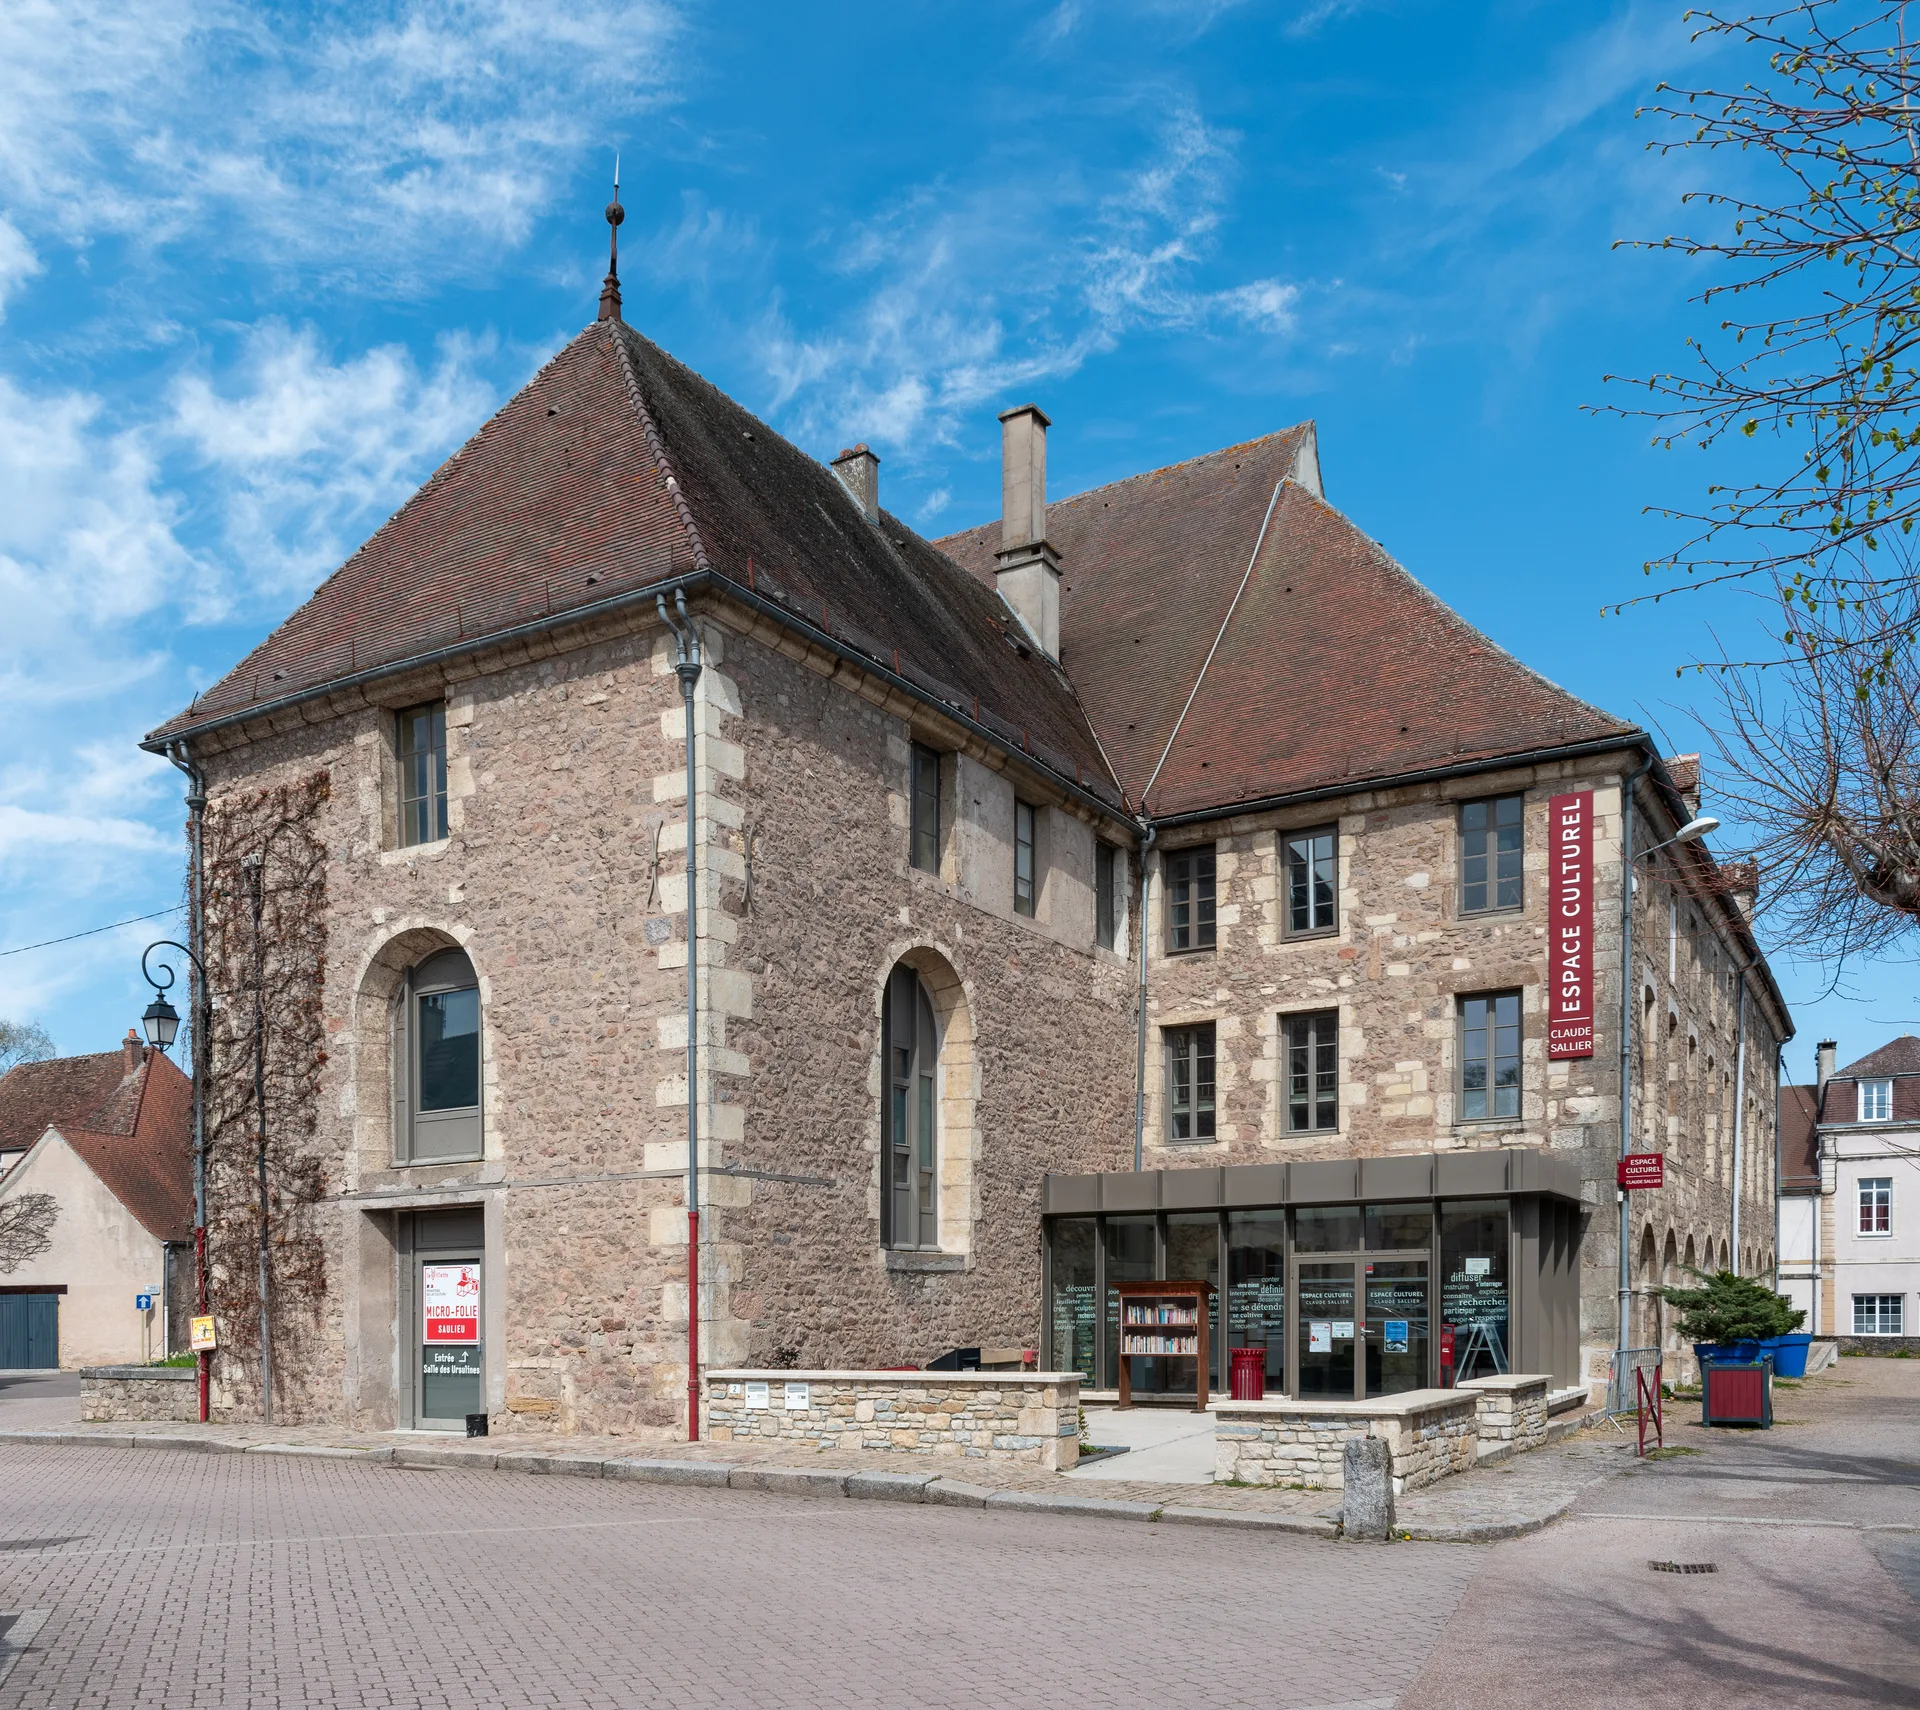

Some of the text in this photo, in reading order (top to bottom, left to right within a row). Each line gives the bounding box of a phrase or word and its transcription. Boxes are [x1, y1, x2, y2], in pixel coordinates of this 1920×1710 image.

[1562, 798, 1581, 1012] ESPACE CULTUREL
[1551, 1026, 1592, 1039] CLAUDE
[1550, 1040, 1592, 1053] SALLIER
[1626, 1166, 1661, 1174] CULTUREL
[1451, 1272, 1483, 1282] diffuser
[1261, 1284, 1283, 1294] définir
[1459, 1298, 1507, 1306] rechercher
[426, 1305, 477, 1317] MICRO-FOLIE
[1444, 1307, 1476, 1316] participer
[438, 1324, 465, 1334] SAULIEU
[435, 1353, 454, 1362] Entrée
[423, 1364, 480, 1374] Salle des Ursulines
